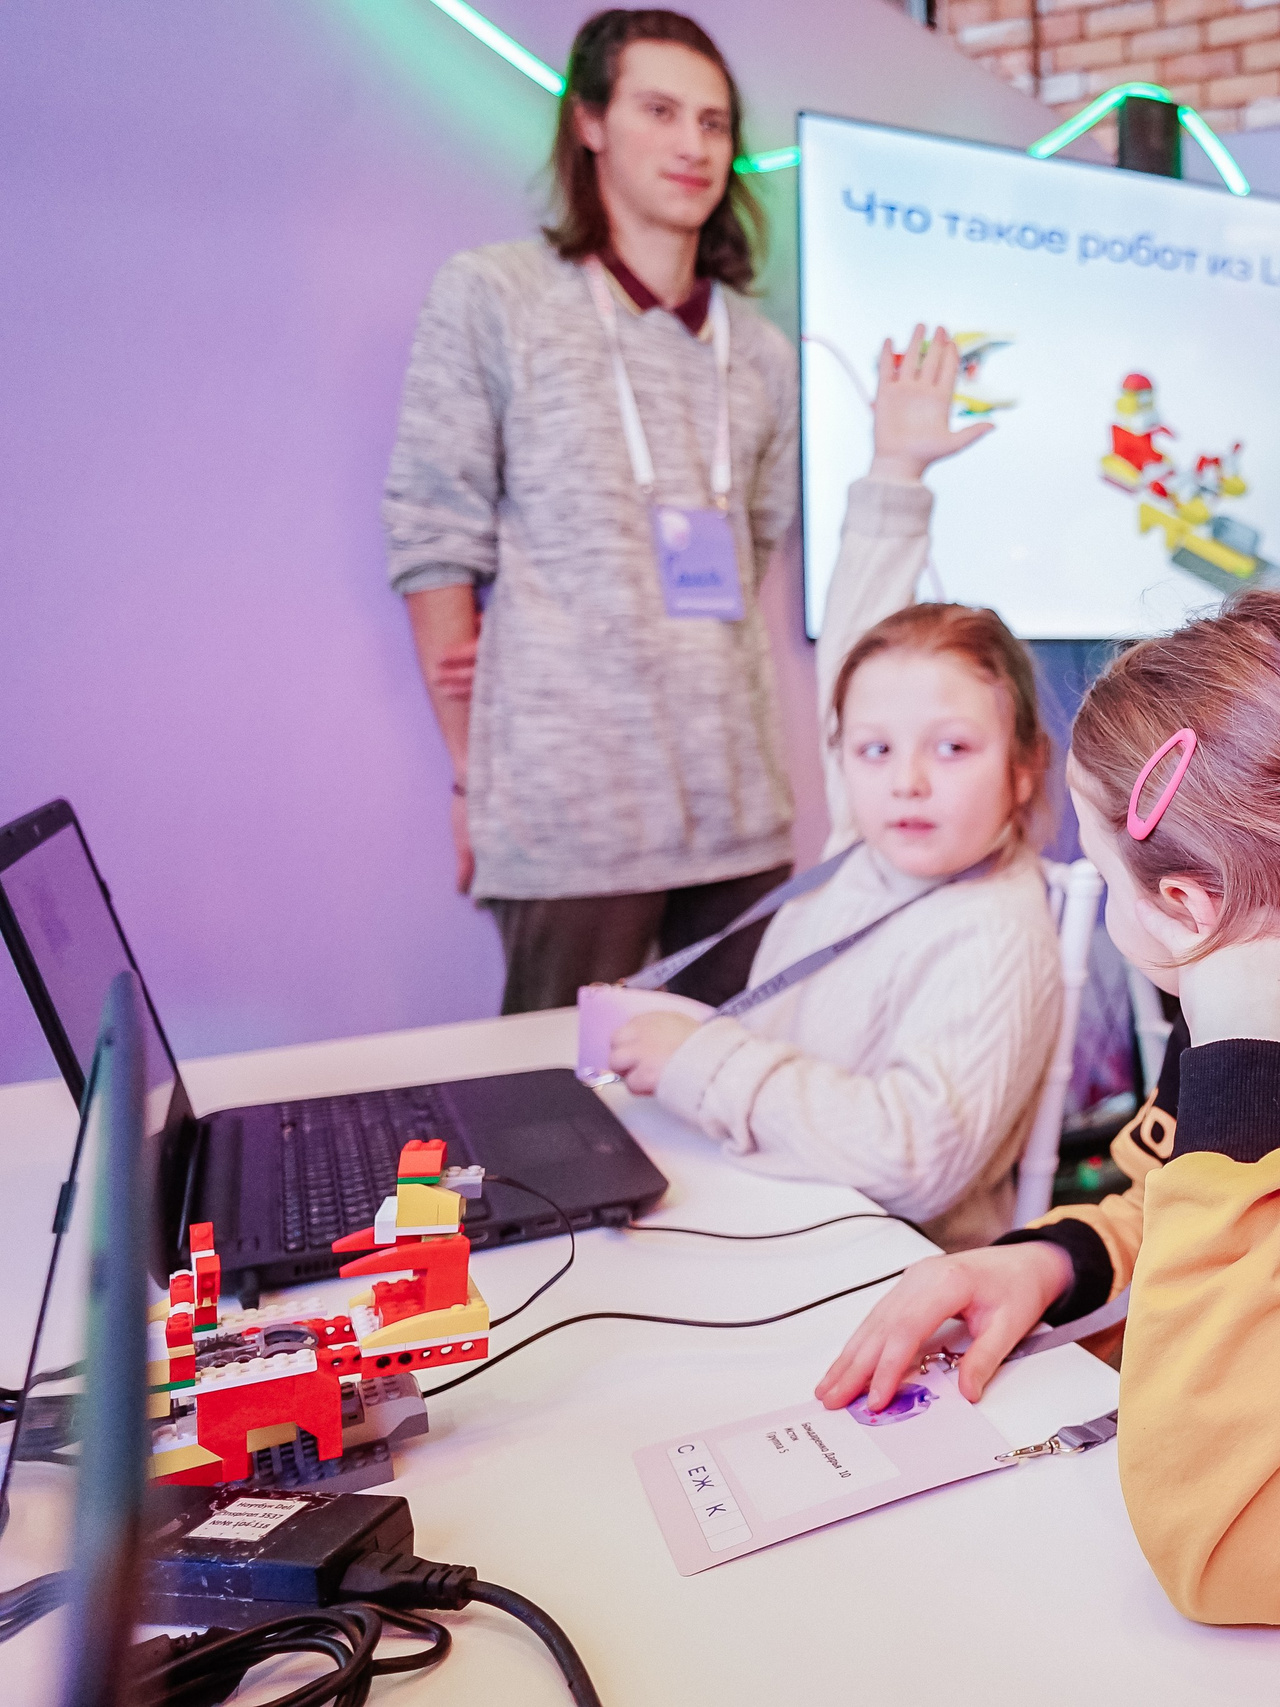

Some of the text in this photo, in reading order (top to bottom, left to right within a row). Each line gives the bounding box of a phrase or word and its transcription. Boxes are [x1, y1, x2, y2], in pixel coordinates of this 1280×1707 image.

[842, 188, 933, 234] Что
[939, 210, 1067, 254] такое
[1076, 233, 1198, 274] робот
[1205, 254, 1253, 282] из
[274, 1503, 295, 1511] Dell
